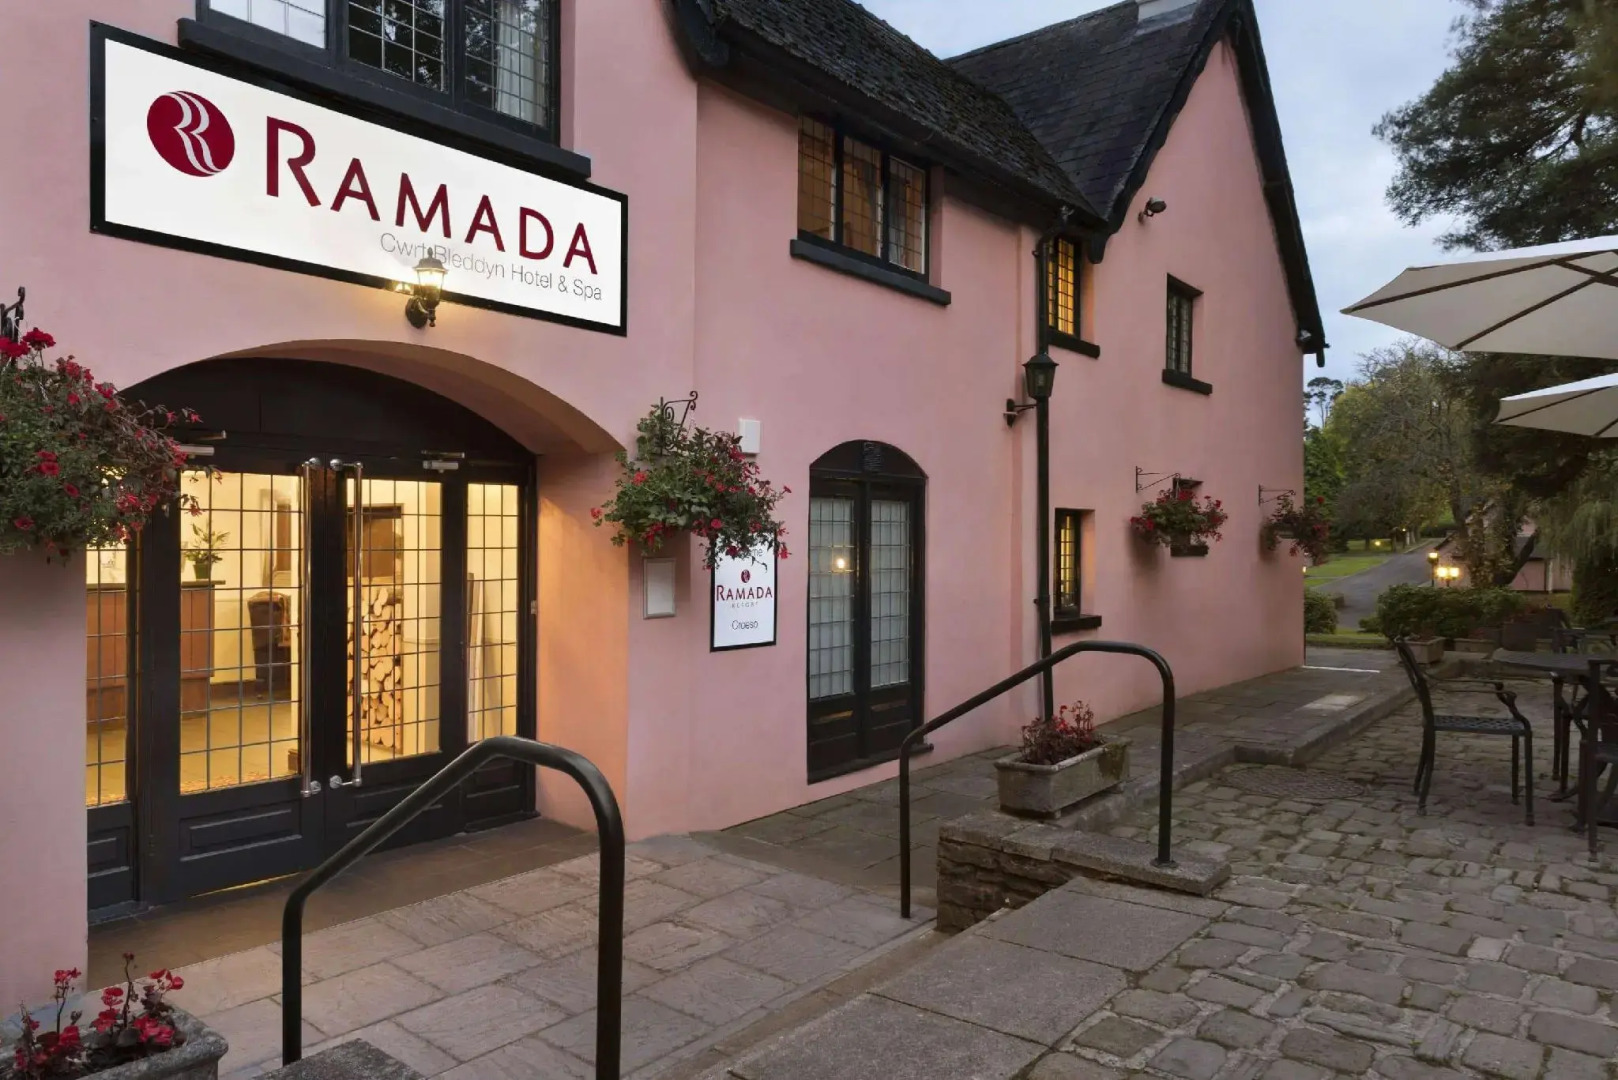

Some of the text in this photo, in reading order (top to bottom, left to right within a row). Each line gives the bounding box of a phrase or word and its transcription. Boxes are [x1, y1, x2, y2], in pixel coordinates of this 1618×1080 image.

[266, 115, 598, 275] RAMADA
[380, 232, 602, 301] Cwrt Bleddyn Hotel & Spa
[716, 584, 773, 602] RAMADA
